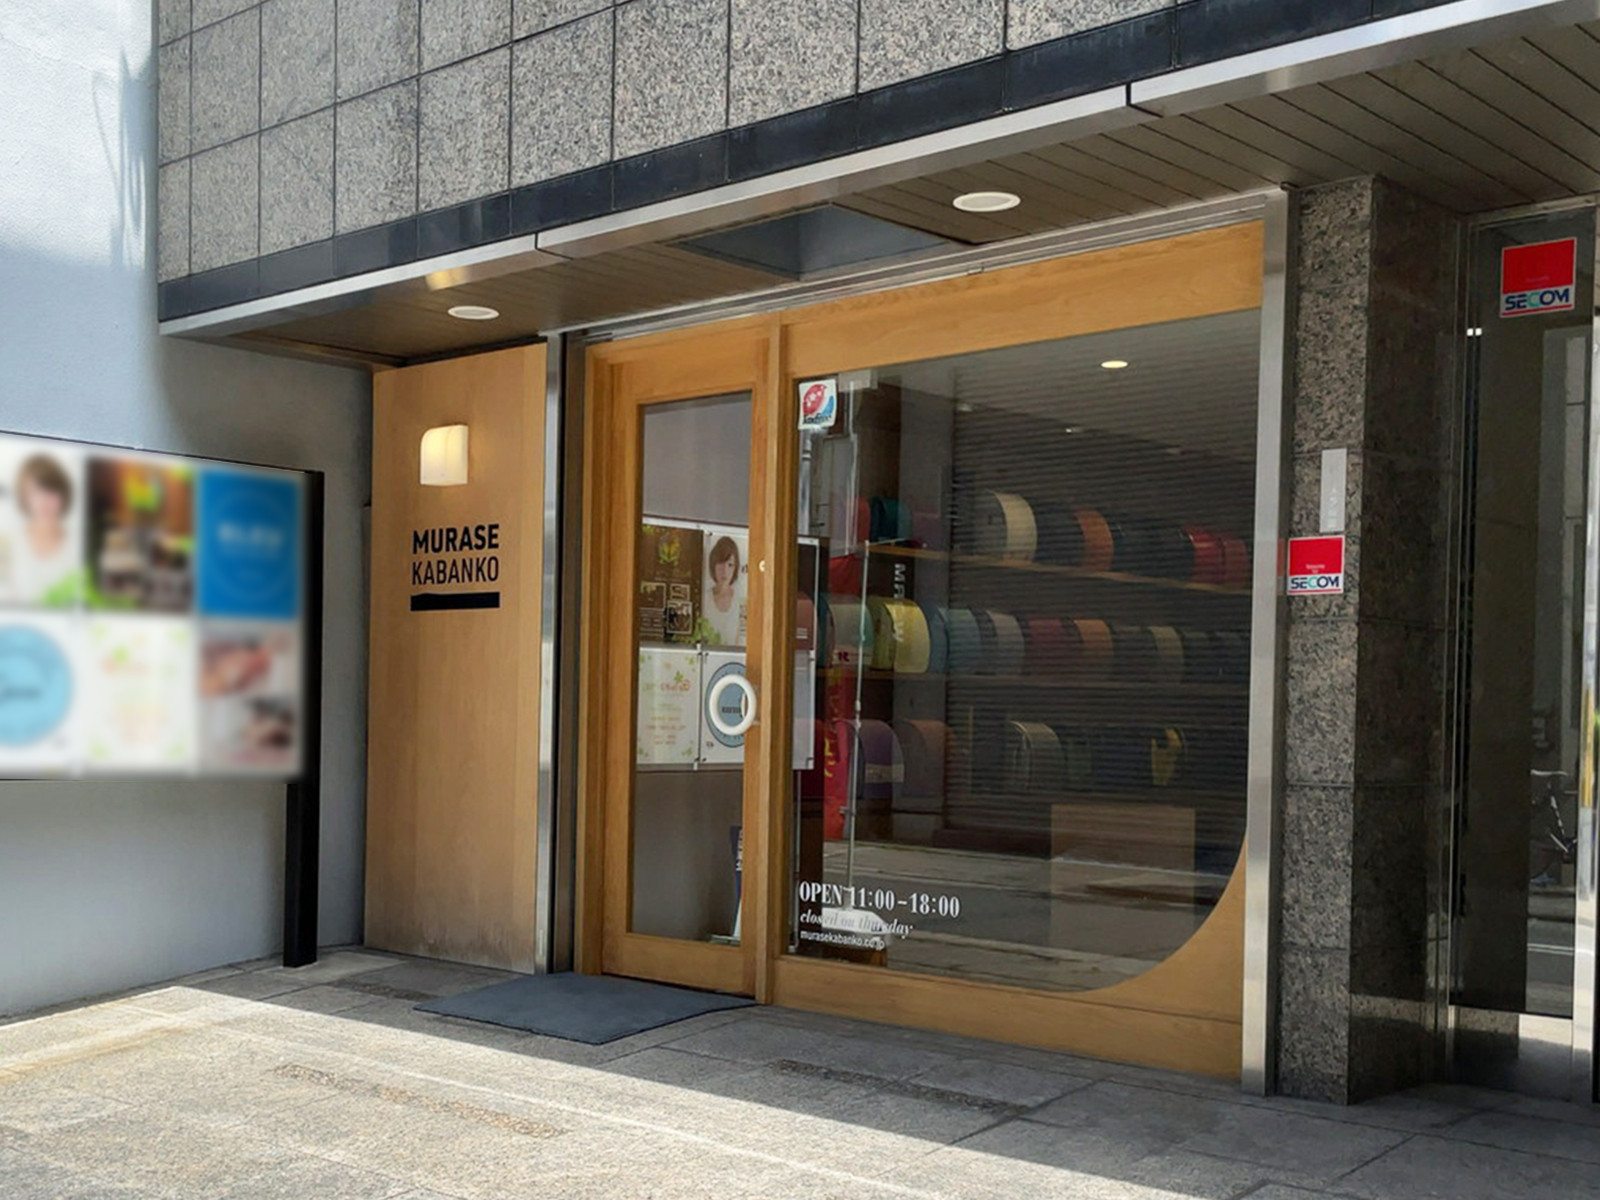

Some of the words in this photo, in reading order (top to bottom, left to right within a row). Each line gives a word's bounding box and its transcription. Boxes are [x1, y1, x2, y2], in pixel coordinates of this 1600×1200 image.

[1504, 287, 1570, 312] SECOM
[413, 523, 500, 555] MURASE
[411, 556, 499, 586] KABANKO
[1290, 576, 1340, 589] SECOM
[799, 881, 843, 905] OPEN
[800, 909, 839, 925] closed
[841, 918, 856, 928] on
